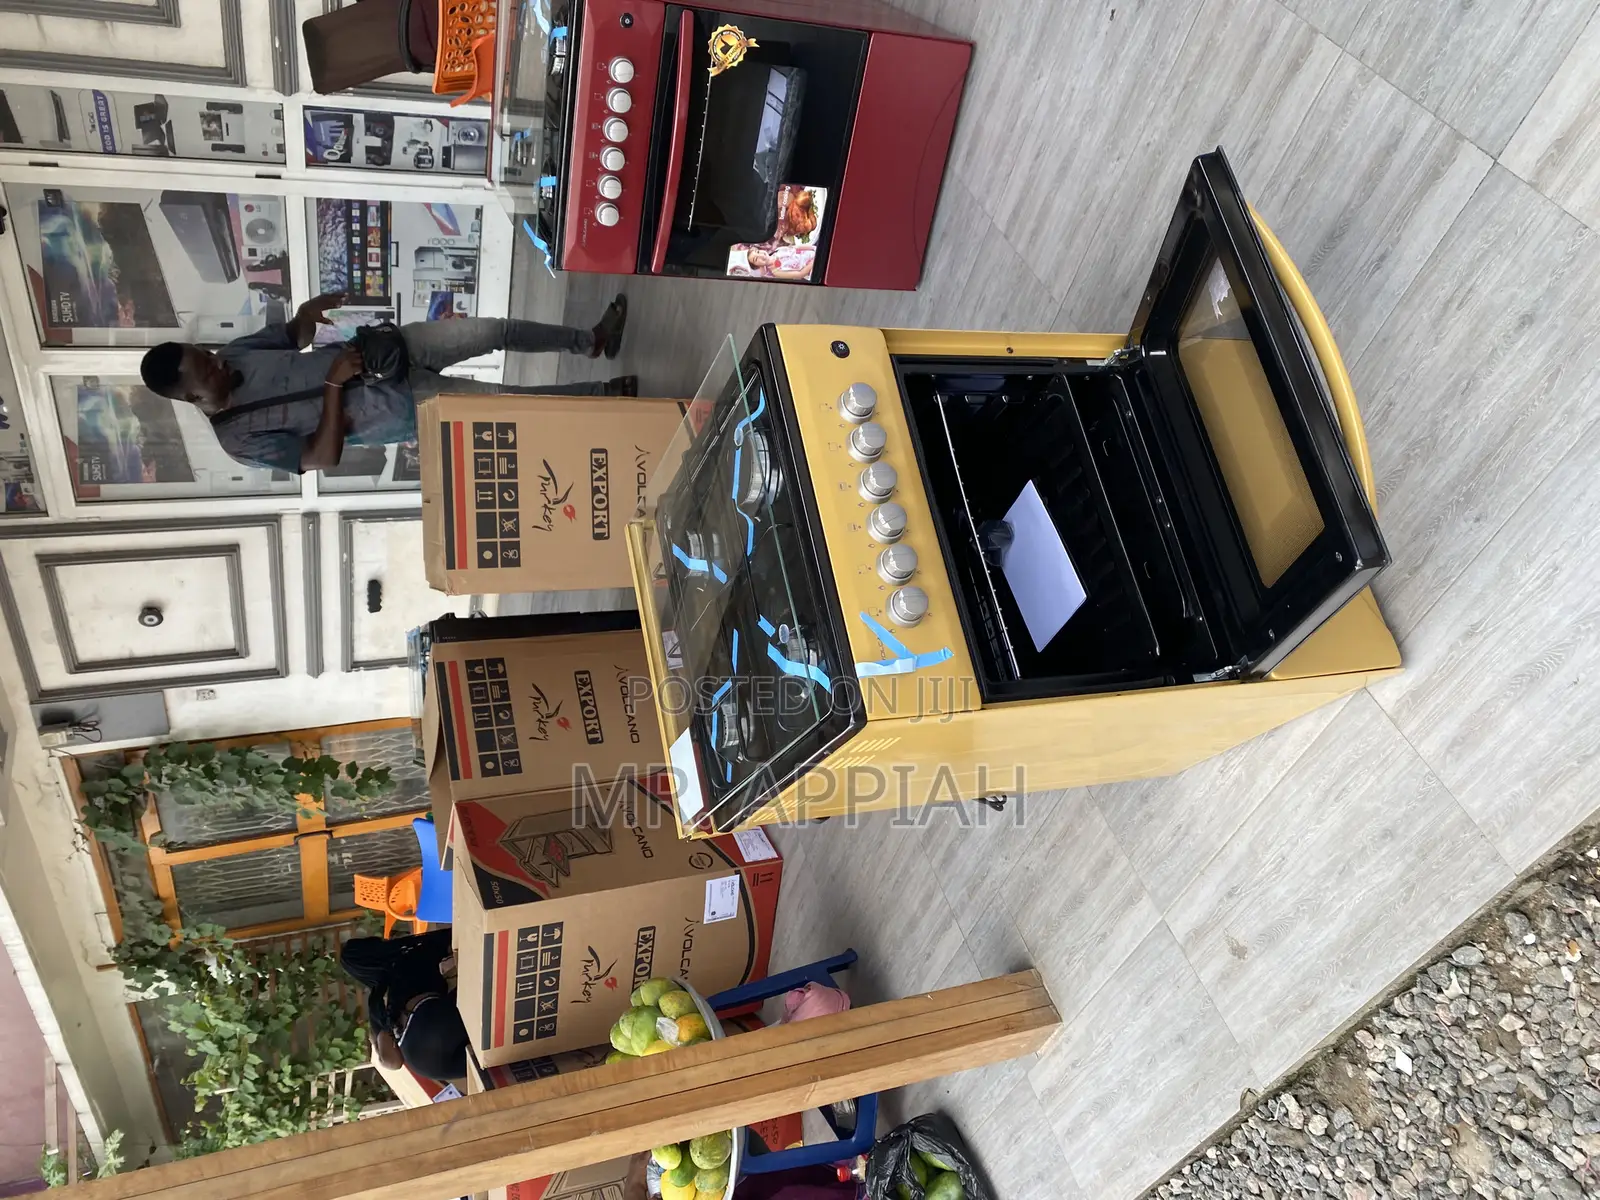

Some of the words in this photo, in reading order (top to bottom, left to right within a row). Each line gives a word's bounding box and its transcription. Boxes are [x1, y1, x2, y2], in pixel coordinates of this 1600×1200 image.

[96, 95, 107, 122] GREAT
[102, 124, 109, 133] IS
[104, 135, 113, 151] GOD
[778, 206, 786, 220] better
[782, 185, 791, 205] cooking
[592, 452, 608, 537] EXPORT
[576, 673, 602, 743] EXPORT
[618, 677, 641, 744] VOLCANO
[624, 808, 654, 860] VOLCANO
[490, 880, 504, 905] 50x50
[633, 929, 654, 989] EXPOR
[680, 928, 694, 976] VOLCA
